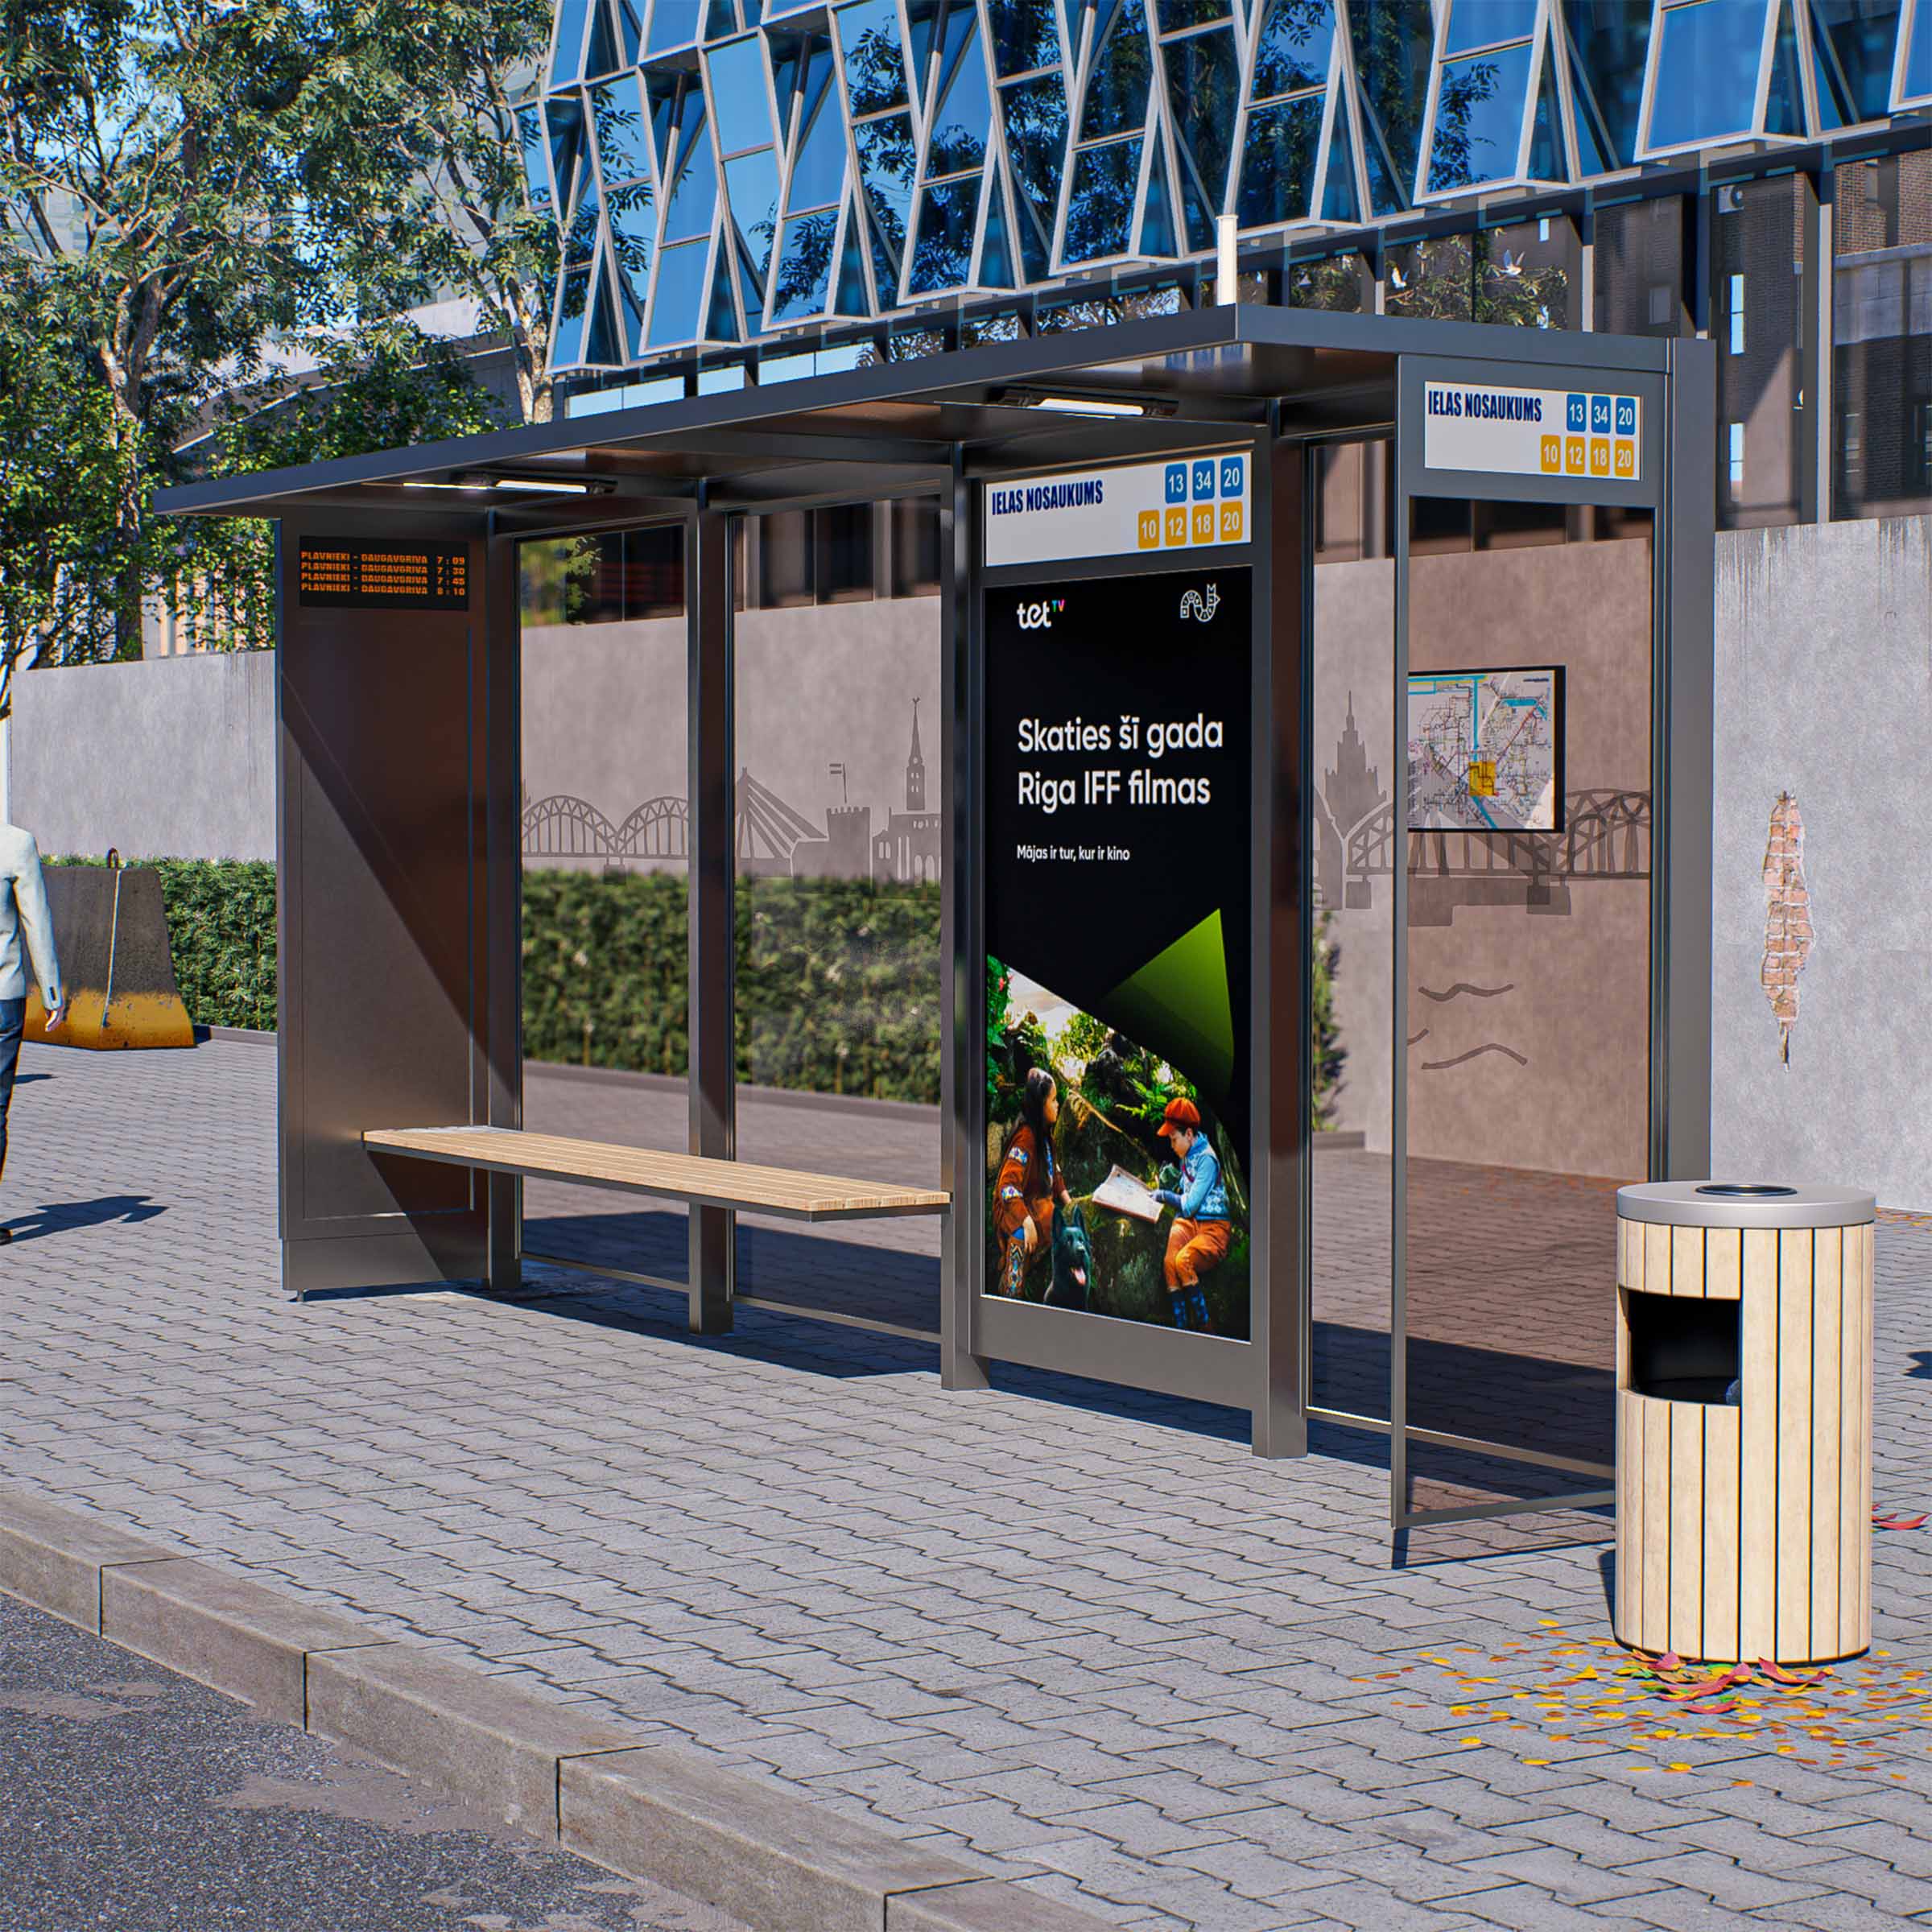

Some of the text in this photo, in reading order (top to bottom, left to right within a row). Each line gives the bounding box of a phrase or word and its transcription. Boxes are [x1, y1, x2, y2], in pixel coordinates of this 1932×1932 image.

[1429, 390, 1542, 422] IELAS NOSAUKUMS
[1570, 403, 1633, 426] 13 34 20
[1544, 444, 1632, 468] 10 12 18 20
[1168, 467, 1240, 493] 13 34 20
[992, 479, 1103, 515] IELAS NOSAUKUMS
[1141, 511, 1240, 539] 10 12 18 20
[1017, 601, 1052, 630] tet
[1018, 716, 1112, 752] Skaties
[1146, 712, 1224, 758] gada
[1018, 769, 1211, 814] Riga IFF filmas
[1017, 844, 1130, 863] Mājas ir tur, kur ir kino
